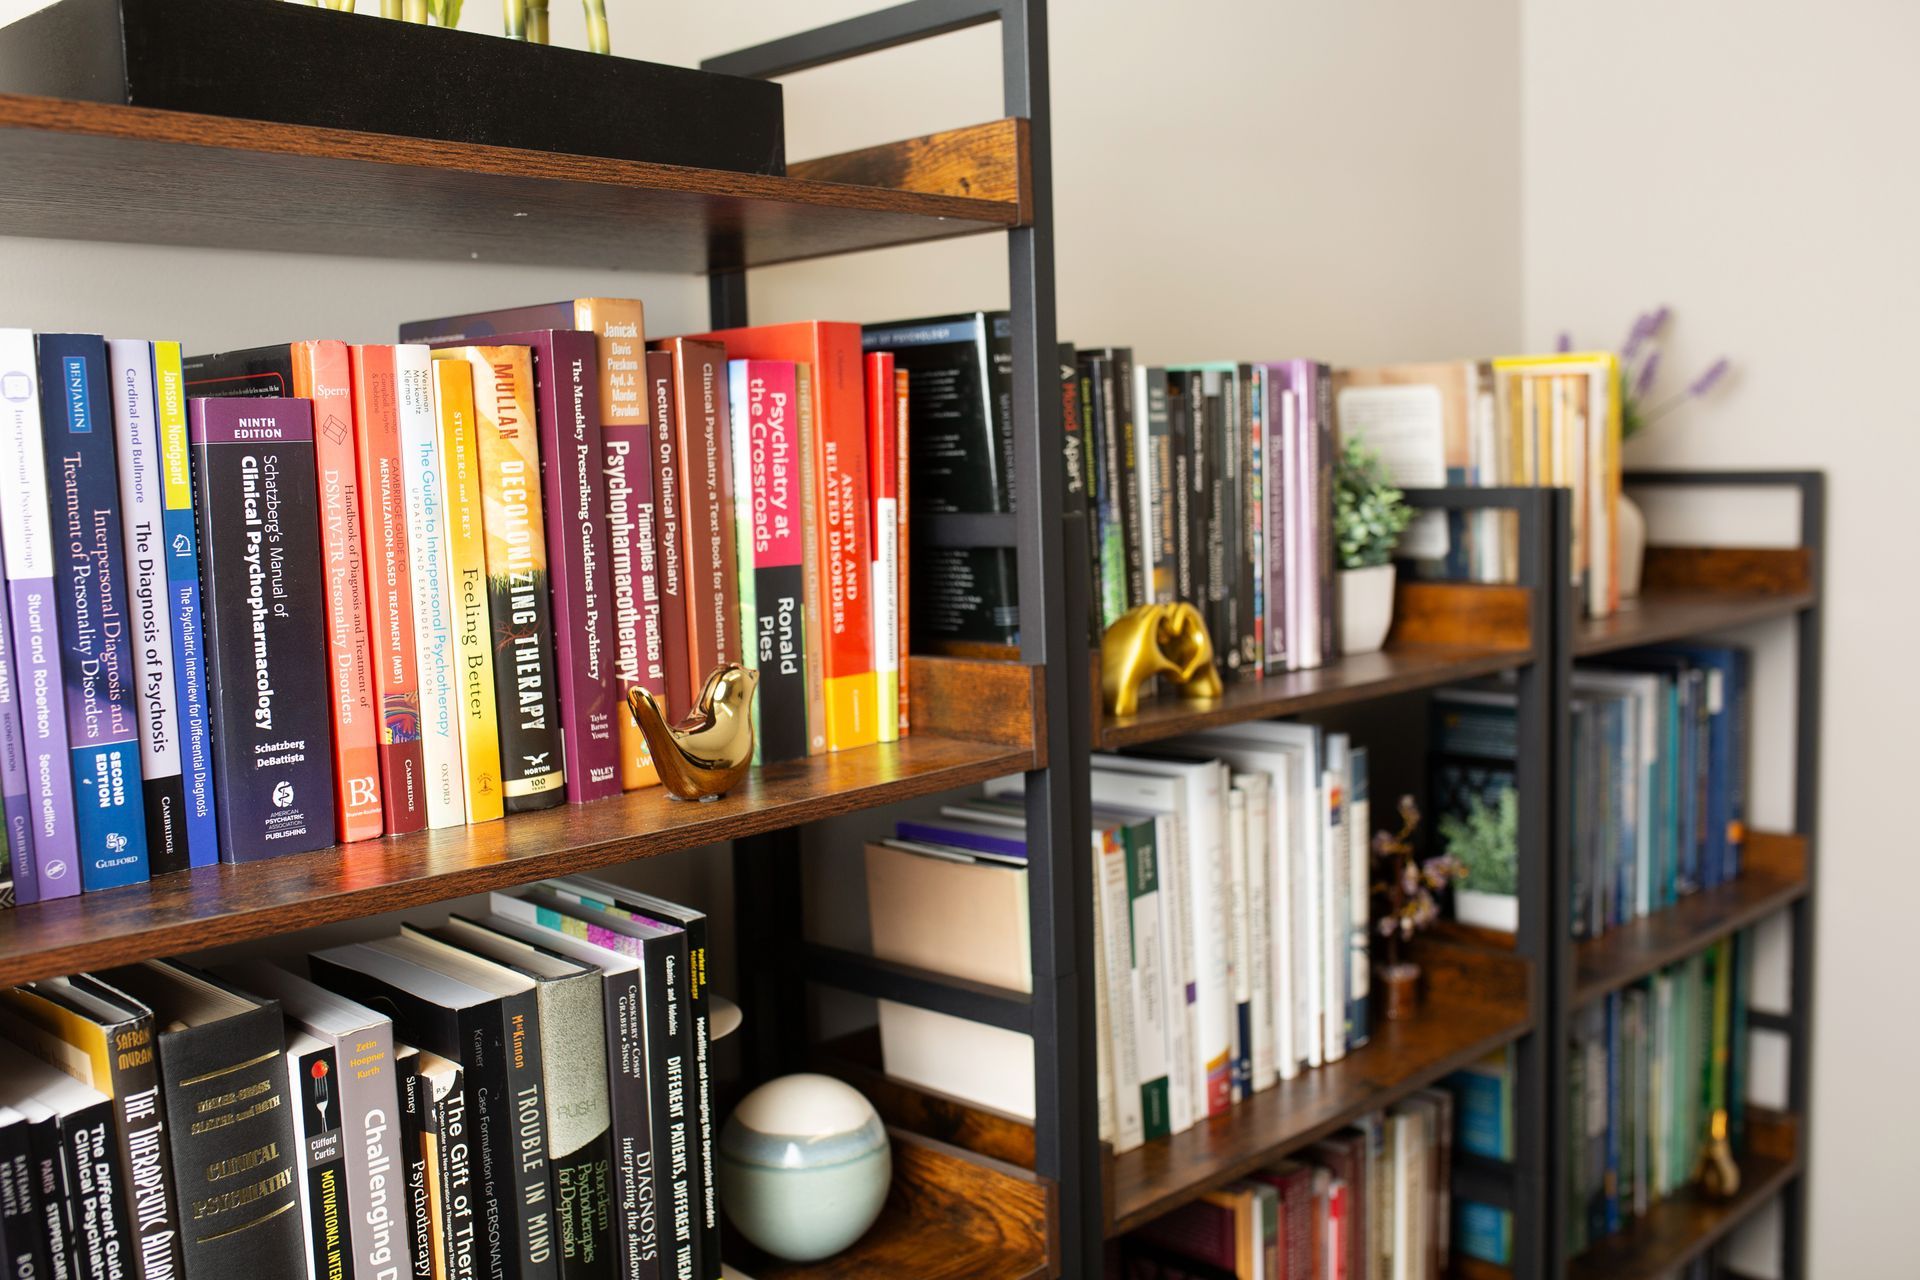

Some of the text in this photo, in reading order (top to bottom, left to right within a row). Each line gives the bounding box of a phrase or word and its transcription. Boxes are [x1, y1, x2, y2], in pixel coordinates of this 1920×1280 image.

[70, 361, 86, 428] BENJAMIN
[164, 369, 185, 486] Jansson Nordgaard
[238, 418, 276, 428] NINTH
[317, 384, 349, 399] Sperry
[403, 370, 413, 406] Klerman
[413, 370, 423, 416] Markowitz
[421, 370, 431, 413] Weissman
[494, 364, 519, 440] MULLAN
[703, 363, 717, 414] Clinical
[126, 368, 148, 504] Cardinal and Bullmore
[234, 428, 283, 439] EDITION
[750, 378, 771, 553] the Crossroads
[770, 393, 790, 509] Psychiatry
[1060, 363, 1083, 494] A Mood Apart
[391, 458, 405, 554] CAMBRIDGE GUIDE
[454, 411, 472, 541] STULBERG and FREY
[656, 379, 680, 597] Lectures On Clinical Psychiatry
[264, 455, 289, 618] Schatzberg's Manual of
[572, 359, 601, 680] The Maudsley Prescribing Guidelines in Psychiatry
[710, 502, 722, 570] Text-Book
[825, 443, 847, 635] RELATED DISORDERS
[840, 474, 859, 601] ANXIETY AND
[63, 452, 104, 738] Treatment Personality Disorders
[242, 456, 274, 731] Clinical Psychopharmacology
[323, 470, 356, 725] DSM-IV-TR Personality Disorders
[345, 485, 371, 710] Handbook of Diagnosis and Treatment of
[380, 459, 404, 685] MENTALIZATION-BASED TREATMENT (MBT)
[419, 442, 451, 739] The Guide to Interpersonal Psychotherapy
[500, 461, 546, 730] DECOLONIZING THERAPY
[603, 441, 641, 682] Psychopharmacotherapy
[637, 503, 662, 661] Principles Practice
[91, 508, 129, 735] Interpersonal Diagnosis and
[135, 521, 168, 754] The Diagnosis Psychosis
[461, 568, 487, 720] Feeling Better
[714, 592, 727, 651] Students
[759, 616, 776, 663] Pies
[778, 597, 798, 676] Ronald
[27, 594, 51, 739] Stuart and Robertson
[181, 587, 208, 818] The Psychiatric Interview for Differential Diagnosis
[95, 753, 111, 808] EDITION
[109, 751, 125, 806] SECOND
[255, 740, 305, 755] Schatzberg
[257, 753, 305, 769] DeBattista
[403, 760, 415, 813] CAMBRIDGE
[441, 763, 451, 806] OXFORD
[524, 765, 550, 776] NORTON
[531, 778, 546, 787] 100
[590, 767, 614, 777] WILEY
[38, 754, 56, 838] Second edition
[160, 796, 174, 856] CAMBRIDGE
[265, 828, 307, 841] PUBLISHING
[268, 820, 303, 831] ASSOCIATION
[270, 808, 299, 819] AMERICAN
[95, 855, 138, 870] GUILFORD
[350, 1052, 385, 1068] Hoepner
[356, 1041, 377, 1052] Zetin
[358, 1066, 381, 1079] Kurth
[474, 1029, 485, 1067] Kramer
[511, 1015, 526, 1069] MacKinnon
[618, 996, 633, 1074] GRABER SINGH
[627, 985, 643, 1080] CROSKERRY COSBY
[406, 1076, 418, 1114] Slavney
[696, 1016, 715, 1228] Modelling Managing Depressive Disorders
[41, 1159, 56, 1194] PARIS
[75, 1129, 96, 1195] Clinical
[91, 1123, 118, 1239] The Different
[207, 1142, 280, 1182] CLINICAL
[311, 1134, 337, 1150] Clifford
[314, 1147, 336, 1160] Curtis
[447, 1090, 472, 1219] The Gift of
[477, 1088, 497, 1197] Case Formulation for
[517, 1084, 551, 1264] TROUBLE IN MIND
[667, 1056, 690, 1241] DIFFERENT DIFFERENT
[321, 1169, 341, 1251] MOTIVATIONAL
[365, 1109, 394, 1265] Challenging
[409, 1159, 432, 1277] Psychotherapy
[556, 1186, 578, 1259] Depression
[574, 1162, 597, 1264] Psychotherapies
[621, 1137, 640, 1232] interpreting the
[636, 1151, 658, 1261] DIAGNOSIS
